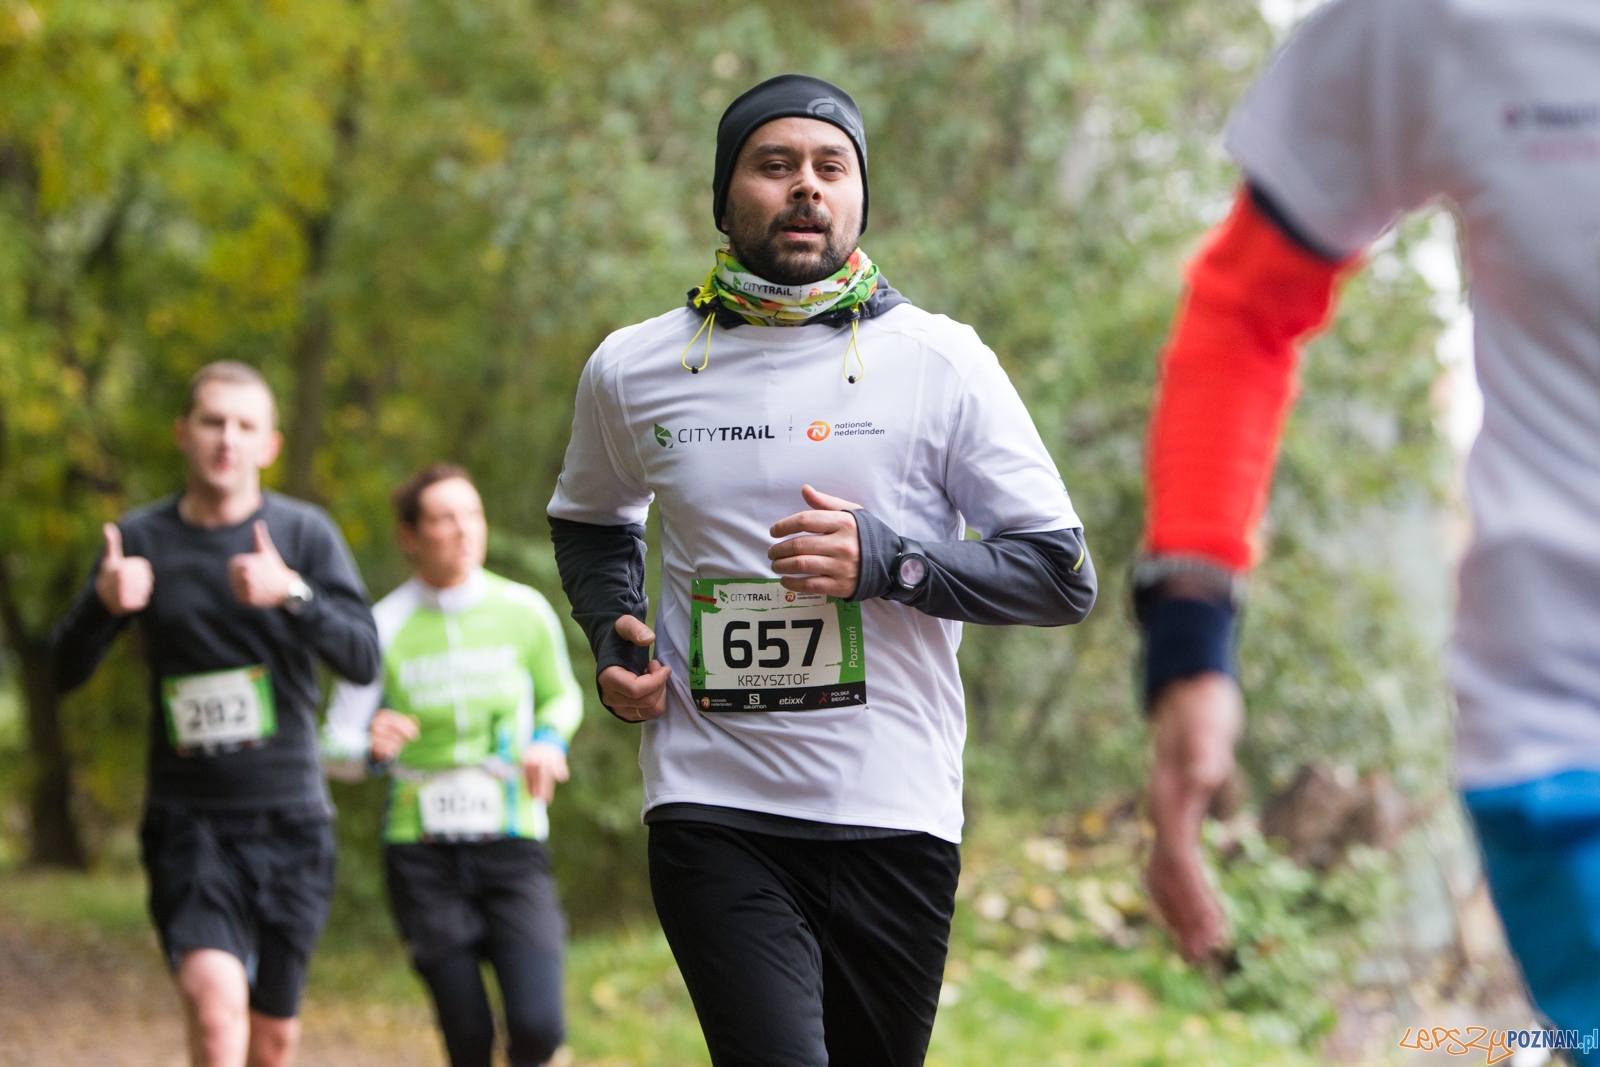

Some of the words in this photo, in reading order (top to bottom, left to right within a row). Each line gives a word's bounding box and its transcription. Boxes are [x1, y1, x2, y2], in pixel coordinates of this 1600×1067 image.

[834, 420, 873, 429] nationale
[834, 428, 886, 437] nederlanden
[723, 618, 825, 669] 657
[846, 626, 859, 668] Poznań
[737, 673, 810, 687] KRZYSZTOF
